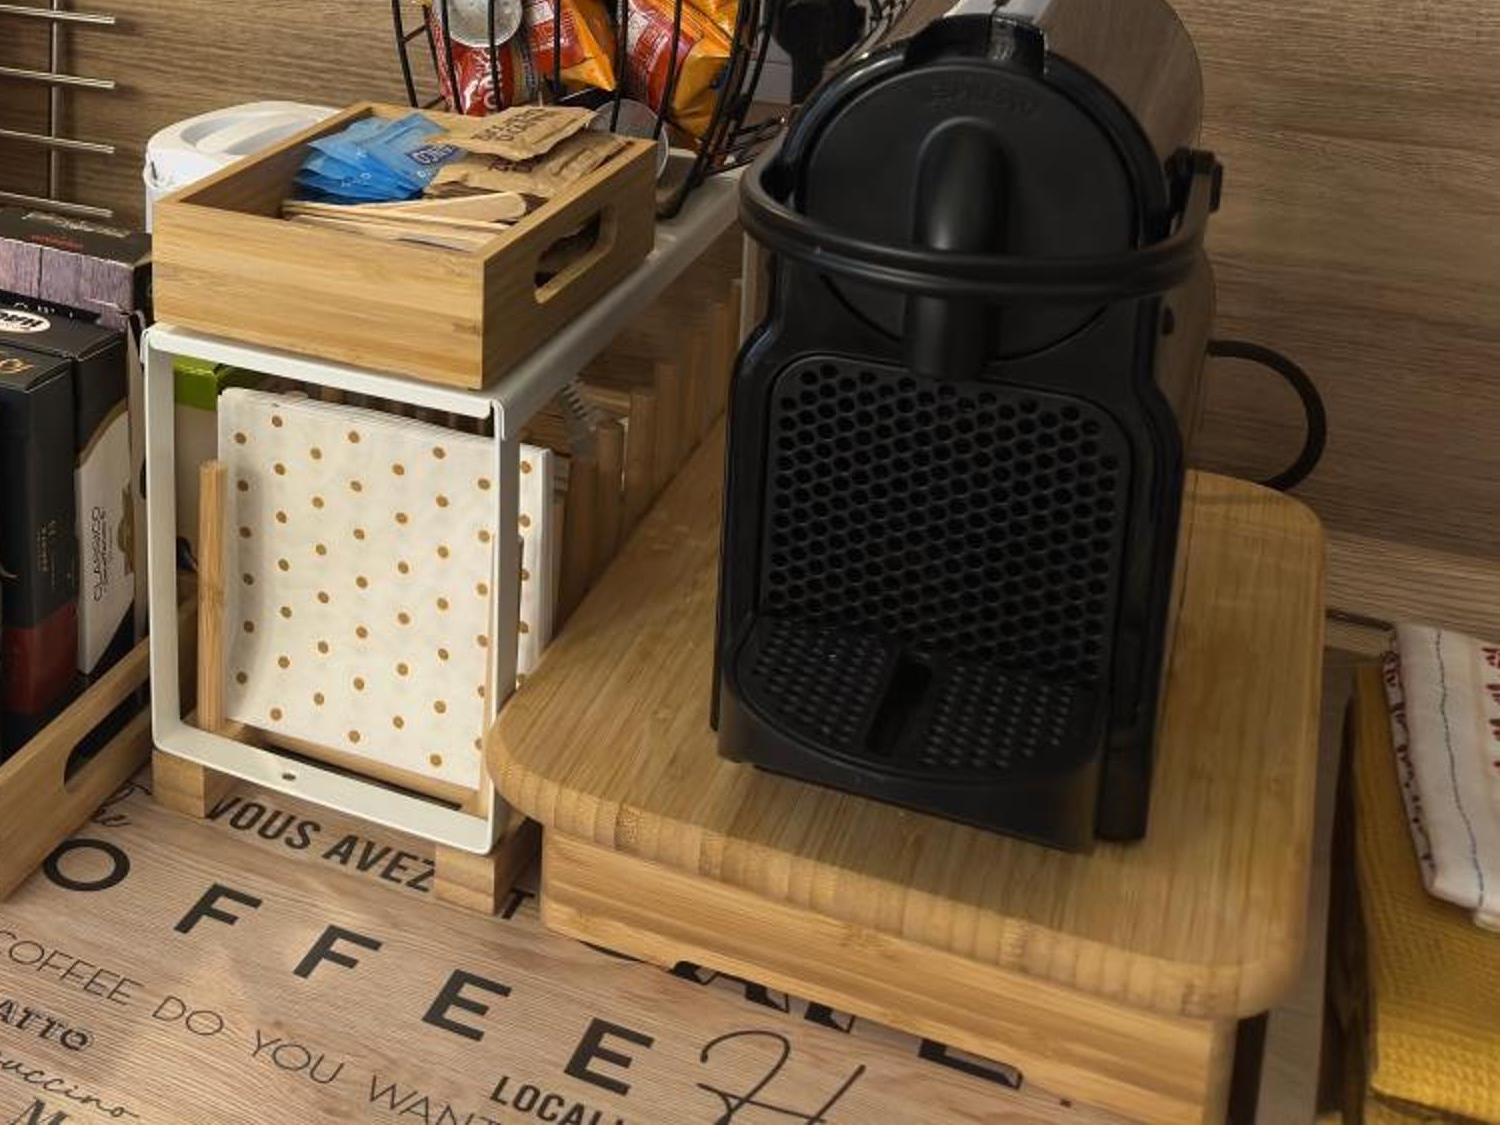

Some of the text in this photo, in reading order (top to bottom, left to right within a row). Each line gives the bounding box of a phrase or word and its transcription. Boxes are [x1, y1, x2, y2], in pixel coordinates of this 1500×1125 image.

[206, 795, 321, 851] VOUS
[322, 833, 436, 893] AVEZ
[152, 995, 224, 1037] DO
[252, 1029, 345, 1084] YOU
